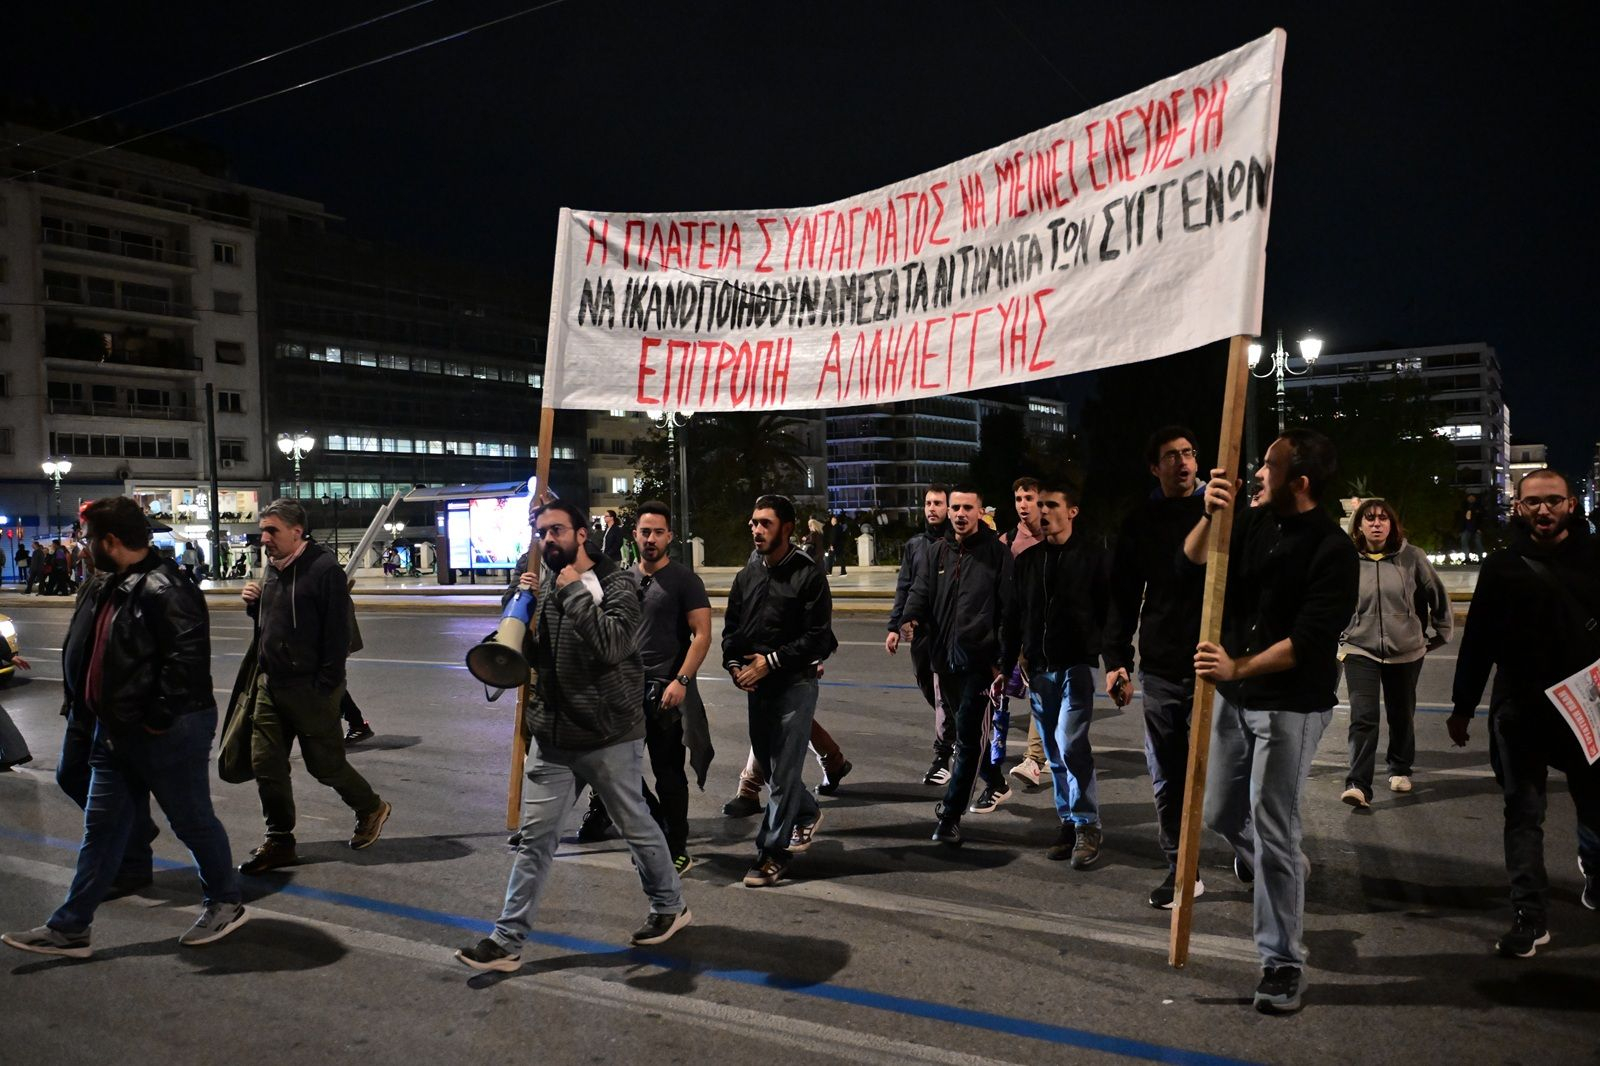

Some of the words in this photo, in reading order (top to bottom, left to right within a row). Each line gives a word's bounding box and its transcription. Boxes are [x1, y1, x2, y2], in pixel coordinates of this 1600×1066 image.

[578, 276, 615, 330] ΝΑ
[821, 267, 899, 327] ΑΜΕΣΑ
[901, 260, 928, 314] ΤΑ
[932, 233, 1043, 310] ΑΙΤΗΜΑΤΑ
[1047, 214, 1095, 271] ΤΩΝ
[1100, 154, 1272, 262] ΣΥΓΓΕΝΩΝ
[586, 219, 608, 266] Η
[624, 219, 741, 272] ΠΛΑΤΕΙΑ
[755, 181, 950, 273] ΣΥΝΤΑΓΜΑΤΟΣ
[960, 173, 986, 233] ΝΑ
[994, 139, 1079, 226] ΜΕΙΝΕΙ
[1085, 80, 1229, 191] ΕΛΕΥΘΕΡΗ
[637, 336, 793, 408] ΕΠΙΤΡΟΠΗ
[815, 288, 1056, 401] ΑΛΛΗΛΕΓΓΥΗΣ
